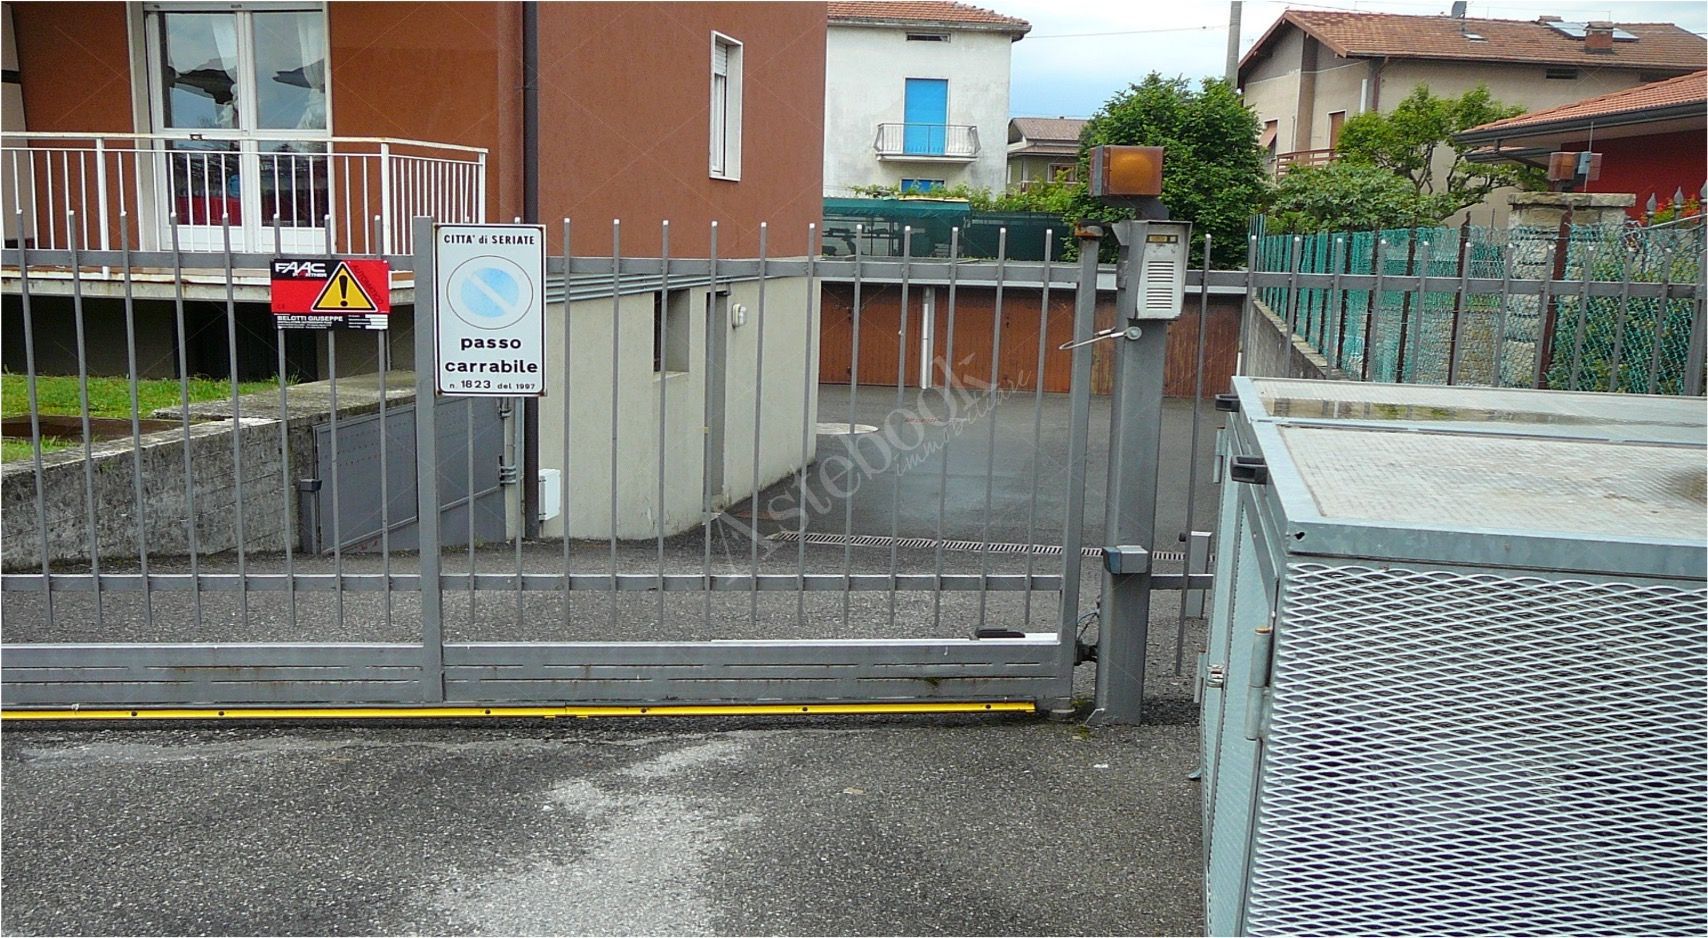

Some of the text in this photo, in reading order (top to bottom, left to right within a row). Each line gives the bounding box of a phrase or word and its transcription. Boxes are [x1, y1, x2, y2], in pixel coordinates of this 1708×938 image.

[443, 234, 535, 245] CITTA' di SERIATE
[274, 261, 326, 273] FAAC
[460, 337, 522, 351] passo
[444, 359, 538, 373] carrabile
[461, 380, 491, 389] 1823
